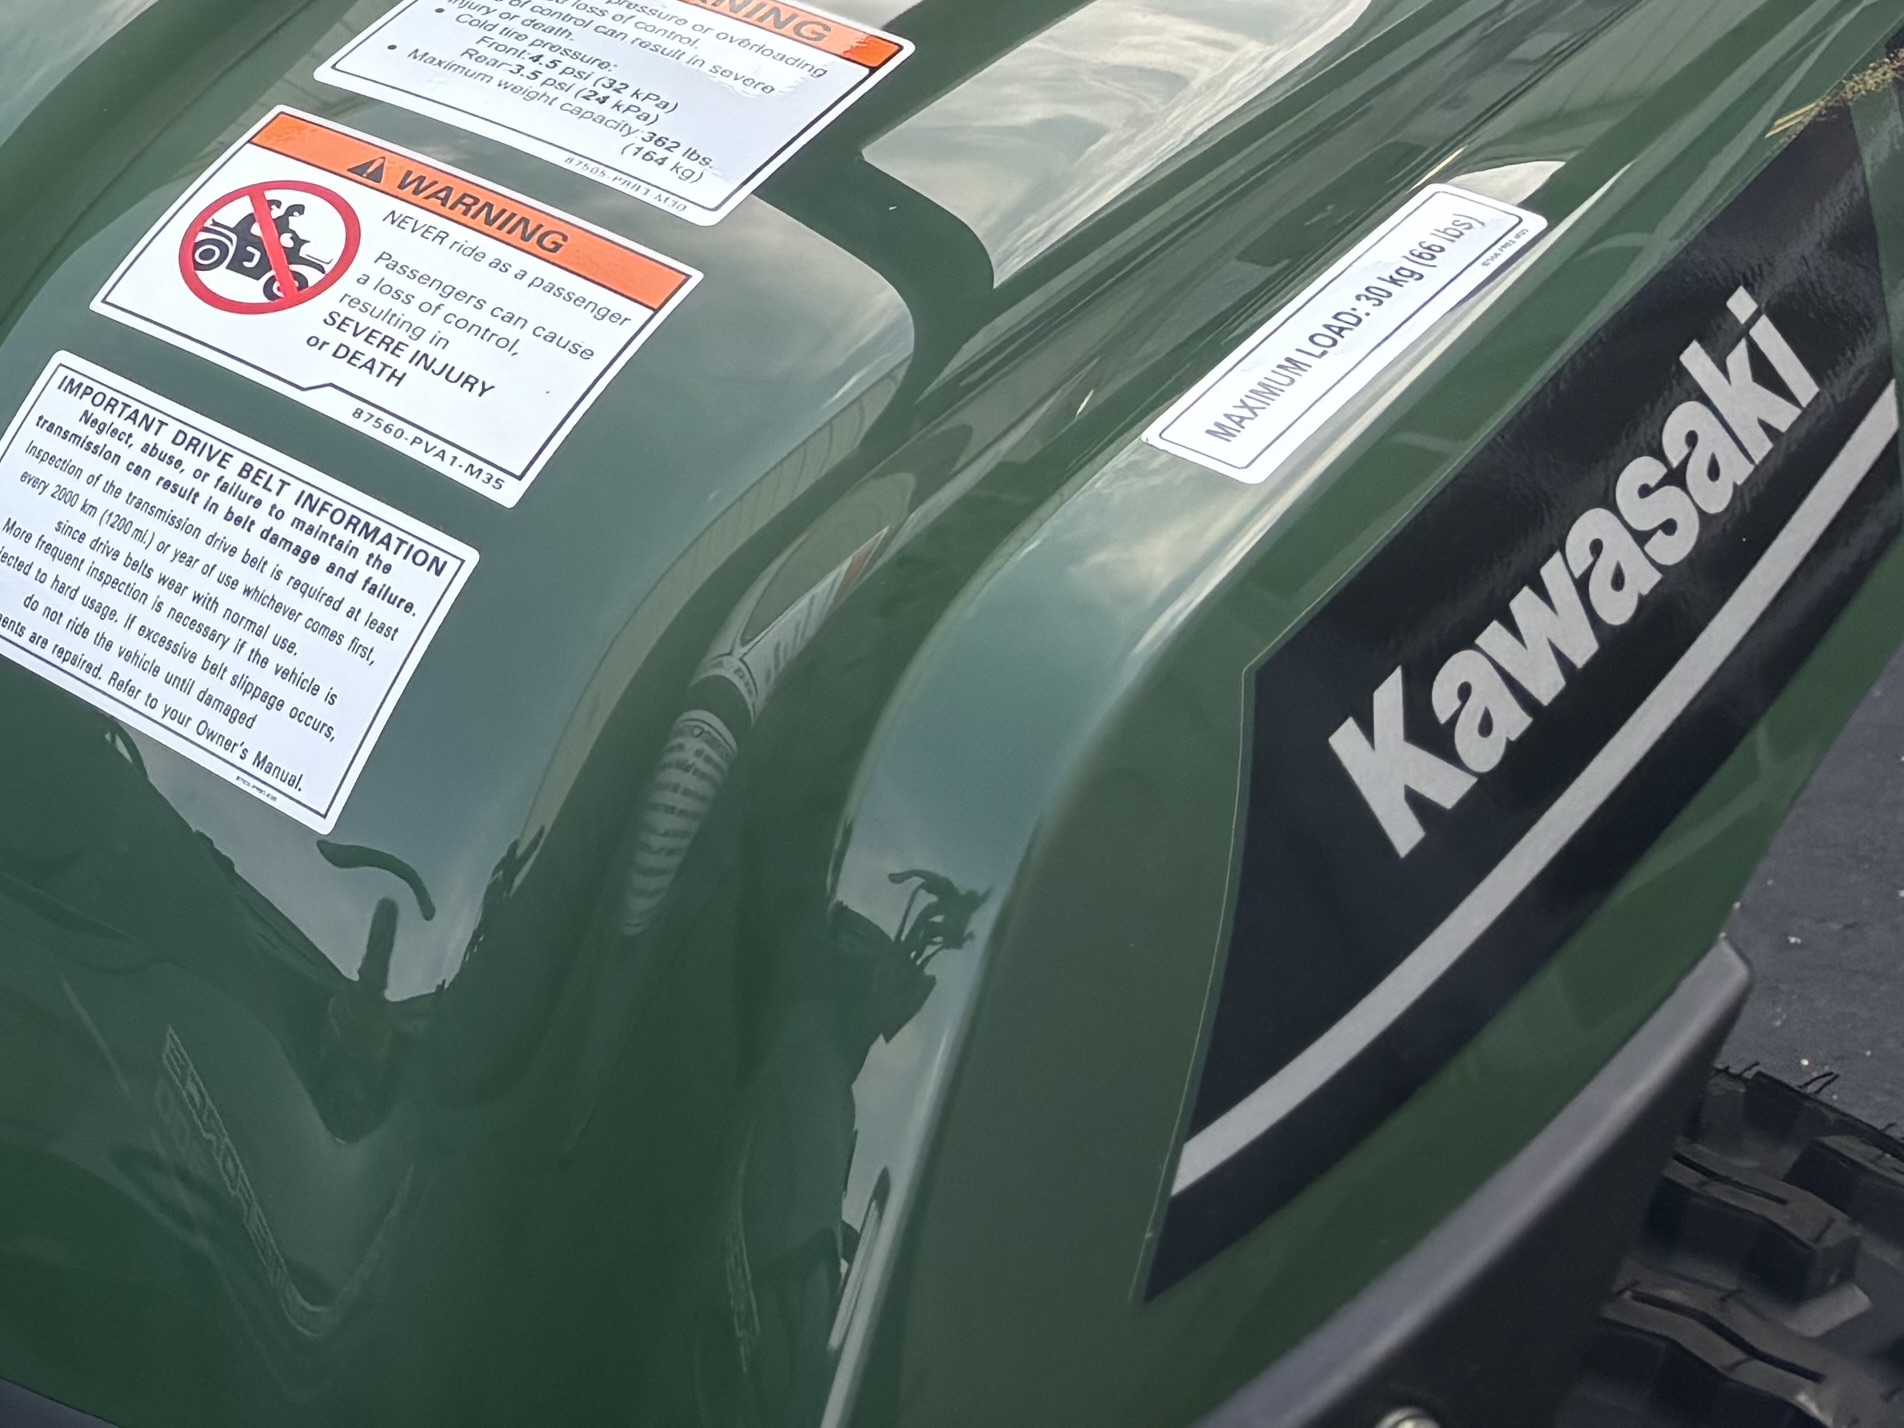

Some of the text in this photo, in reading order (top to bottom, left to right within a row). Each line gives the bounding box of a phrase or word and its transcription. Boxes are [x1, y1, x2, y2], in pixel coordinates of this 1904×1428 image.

[455, 13, 618, 73] Cold tire pressure:
[498, 11, 521, 22] or
[520, 18, 575, 42] death.
[529, 4, 595, 29] control
[593, 24, 629, 42] can
[630, 37, 686, 61] result
[685, 54, 706, 68] in
[708, 64, 776, 95] severe
[611, 13, 637, 25] of
[633, 21, 701, 50] control.
[691, 23, 715, 35] or
[715, 31, 829, 79] overloading
[406, 48, 494, 84] Maximum
[496, 79, 559, 107] weight
[681, 146, 714, 169] lbs.
[539, 77, 576, 93] psi
[573, 87, 611, 106] (24
[610, 99, 660, 127] kPa)
[558, 66, 595, 81] psi
[592, 76, 630, 95] (32
[629, 87, 679, 115] kPa)
[394, 169, 570, 256] WARNING
[620, 142, 704, 184] (164 kg)
[338, 292, 450, 351] resulting in
[355, 273, 521, 357] a loss of control,
[373, 250, 595, 361] Passengers can cause
[381, 209, 632, 326] NEVER ride as a passenger
[305, 335, 408, 388] or DEATH
[322, 310, 496, 398] SEVERE INJURY
[1204, 357, 1312, 442] MAXIMUM
[1295, 307, 1371, 360] LOAD:
[1355, 284, 1393, 308] 30
[1377, 260, 1425, 288] kg
[1404, 239, 1448, 269] (66
[1430, 213, 1486, 245] lbs)
[56, 374, 448, 578] IMPORTANT DRIVE BELT INFORMATION
[78, 408, 393, 575] Neglect, abuse, or failure to maintain the
[352, 406, 506, 492] 87560-PVA1-M35
[19, 470, 51, 496] every
[49, 483, 80, 508] 2000
[79, 497, 98, 519] km
[98, 508, 134, 535] (1200
[155, 540, 172, 555] or
[169, 547, 201, 570] year
[200, 563, 218, 578] of
[216, 570, 240, 591] use
[242, 583, 304, 624] whichever
[303, 617, 345, 647] comes
[346, 635, 375, 667] first,
[24, 439, 400, 642] Inspection of the transmission drive belt is required at least
[35, 414, 416, 618] transmission can result in belt damage and failure.
[1328, 285, 1819, 858] Kawasaki
[1, 516, 338, 706] More frequent inspection is necessary if the vehicle is
[54, 519, 298, 657] since drive belts wear with normal use.
[22, 593, 259, 730] do not ride the vehicle until damaged
[33, 567, 48, 585] to
[49, 573, 81, 601] hard
[80, 593, 119, 624] usage.
[122, 612, 138, 631] If
[137, 624, 198, 665] excessive
[200, 653, 229, 681] belt
[229, 672, 286, 712] slippage
[288, 706, 335, 743] occurs,
[28, 631, 49, 650] are
[51, 643, 104, 681] repaired.
[107, 670, 143, 700] Refer
[143, 692, 159, 710] to
[160, 703, 193, 728] your
[195, 719, 249, 761] Owner's
[251, 750, 304, 792] Manual.
